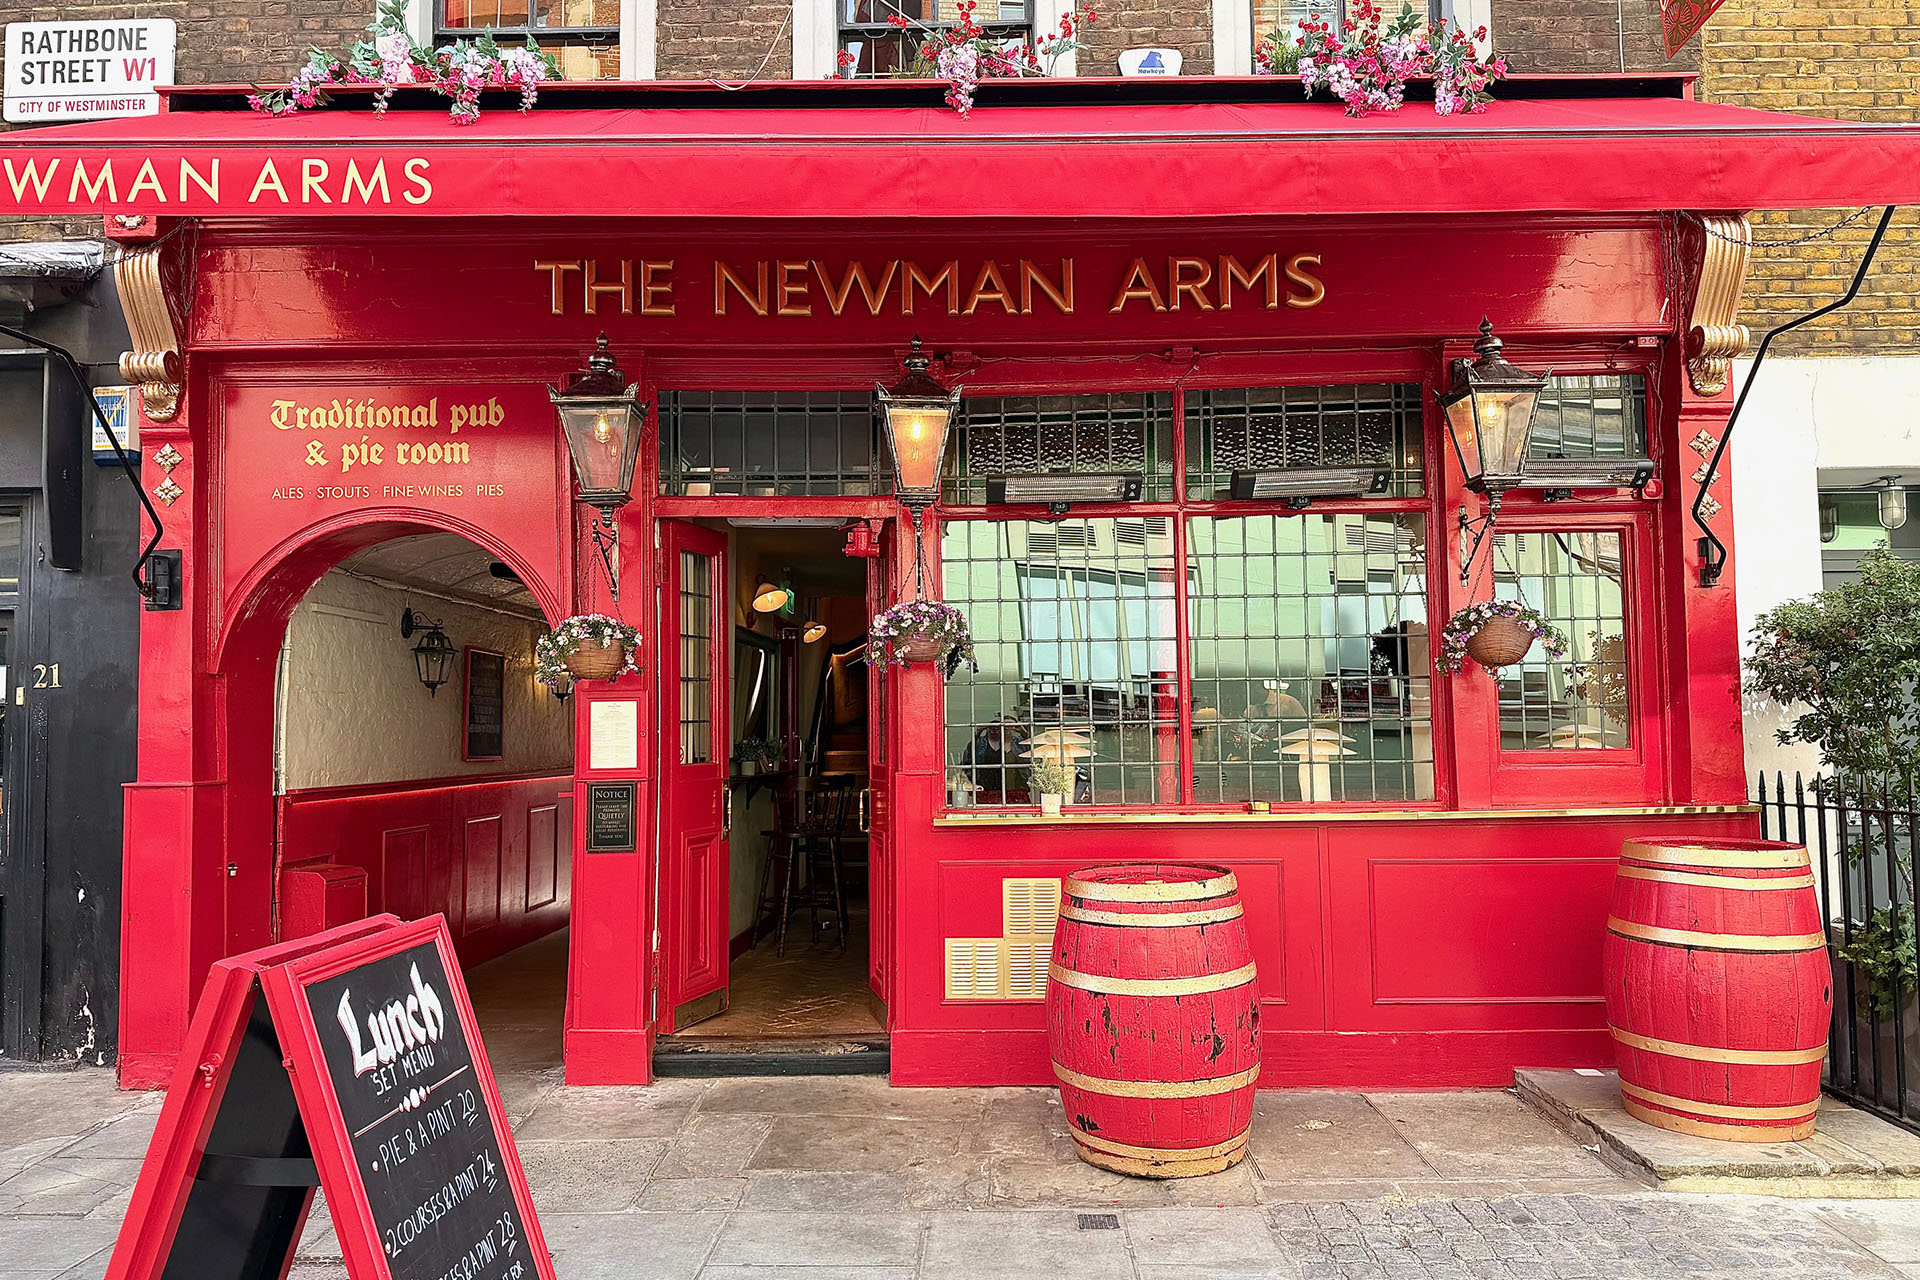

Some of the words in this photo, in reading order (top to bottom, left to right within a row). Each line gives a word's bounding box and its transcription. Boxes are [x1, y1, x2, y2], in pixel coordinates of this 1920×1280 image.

[21, 27, 148, 54] RATHBONE
[21, 59, 111, 85] STREET
[122, 57, 156, 82] W1
[19, 101, 43, 113] CITY
[47, 100, 62, 112] OF
[65, 99, 146, 112] WESTMINSTER
[3, 157, 220, 204] WMAN
[248, 156, 434, 205] ARMS
[534, 258, 676, 316] THE
[714, 258, 1075, 316] NEWMAN
[1107, 252, 1326, 314] ARMS
[270, 397, 439, 431] Traditional
[450, 396, 506, 434] pub
[304, 439, 329, 467] &
[341, 434, 385, 473] pie
[396, 441, 471, 465] room
[271, 487, 304, 499] ALES
[316, 485, 371, 499] STOUTS
[383, 485, 414, 498] FINE
[417, 484, 464, 498] WINES
[476, 484, 505, 497] PIES
[32, 663, 63, 689] 21
[596, 791, 627, 799] NOTICE
[337, 960, 445, 1079] Lunch
[371, 1062, 398, 1096] SET
[401, 1044, 435, 1079] MENU
[379, 1134, 407, 1176] PIE
[405, 1128, 418, 1155] &
[417, 1120, 431, 1148] A
[426, 1099, 457, 1140] PINT
[457, 1088, 476, 1120] 20
[454, 1163, 479, 1201] PINT
[476, 1148, 496, 1184] 24
[474, 1229, 498, 1269] PINT
[495, 1211, 515, 1247] 28
